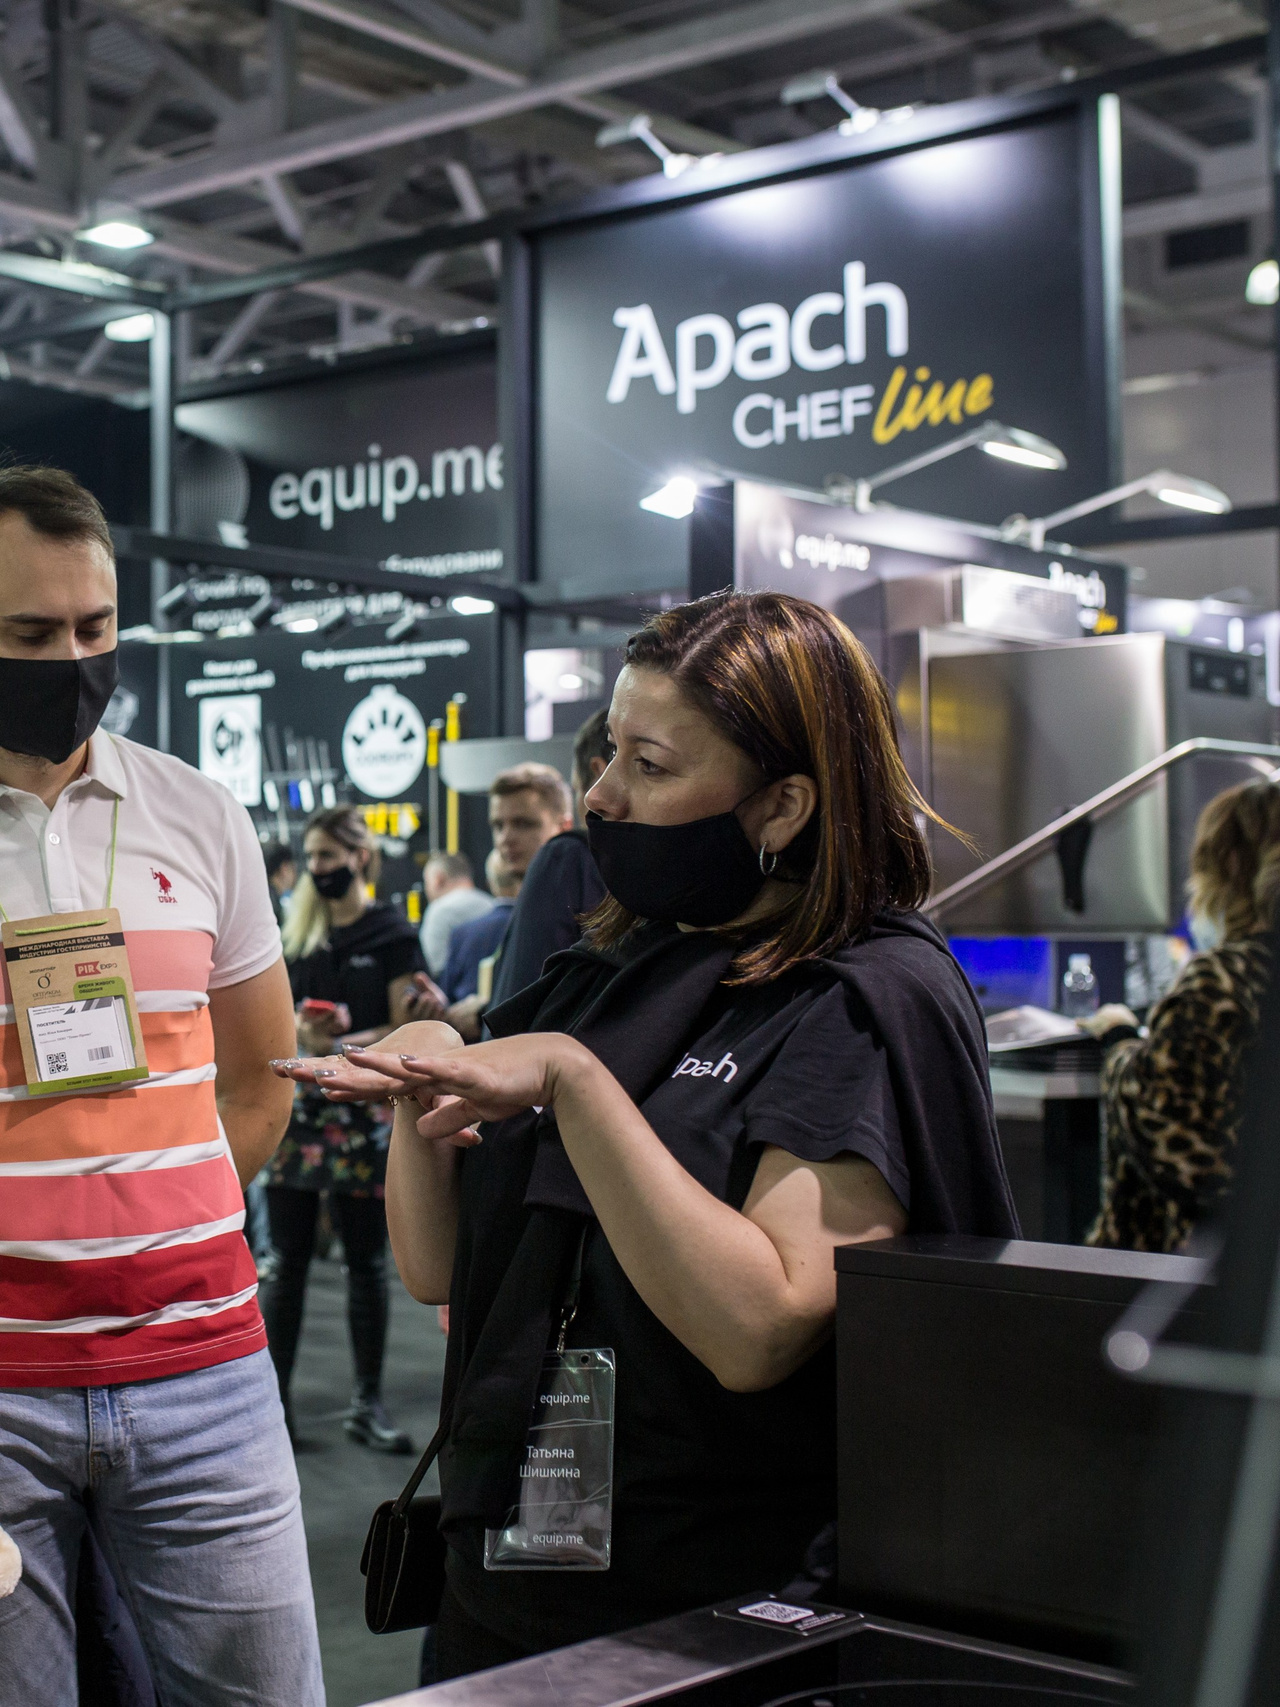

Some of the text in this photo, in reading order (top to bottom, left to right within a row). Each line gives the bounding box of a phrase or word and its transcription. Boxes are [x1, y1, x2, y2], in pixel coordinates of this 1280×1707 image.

[606, 260, 909, 414] Apach
[732, 383, 875, 449] CHEF
[18, 934, 110, 952] МЕЖДУНАРОДНАЯ ВЫСТАВКА
[19, 941, 112, 959] ИНДУСТРИИ ГОСТЕПРИИМСТВА
[77, 963, 96, 975] PIR
[36, 1019, 66, 1028] ПОСЕТИТЕЛЬ
[539, 1392, 591, 1406] equip.me
[526, 1445, 575, 1459] Татьяна
[519, 1464, 581, 1478] Шишкина
[532, 1532, 584, 1547] equip.me
